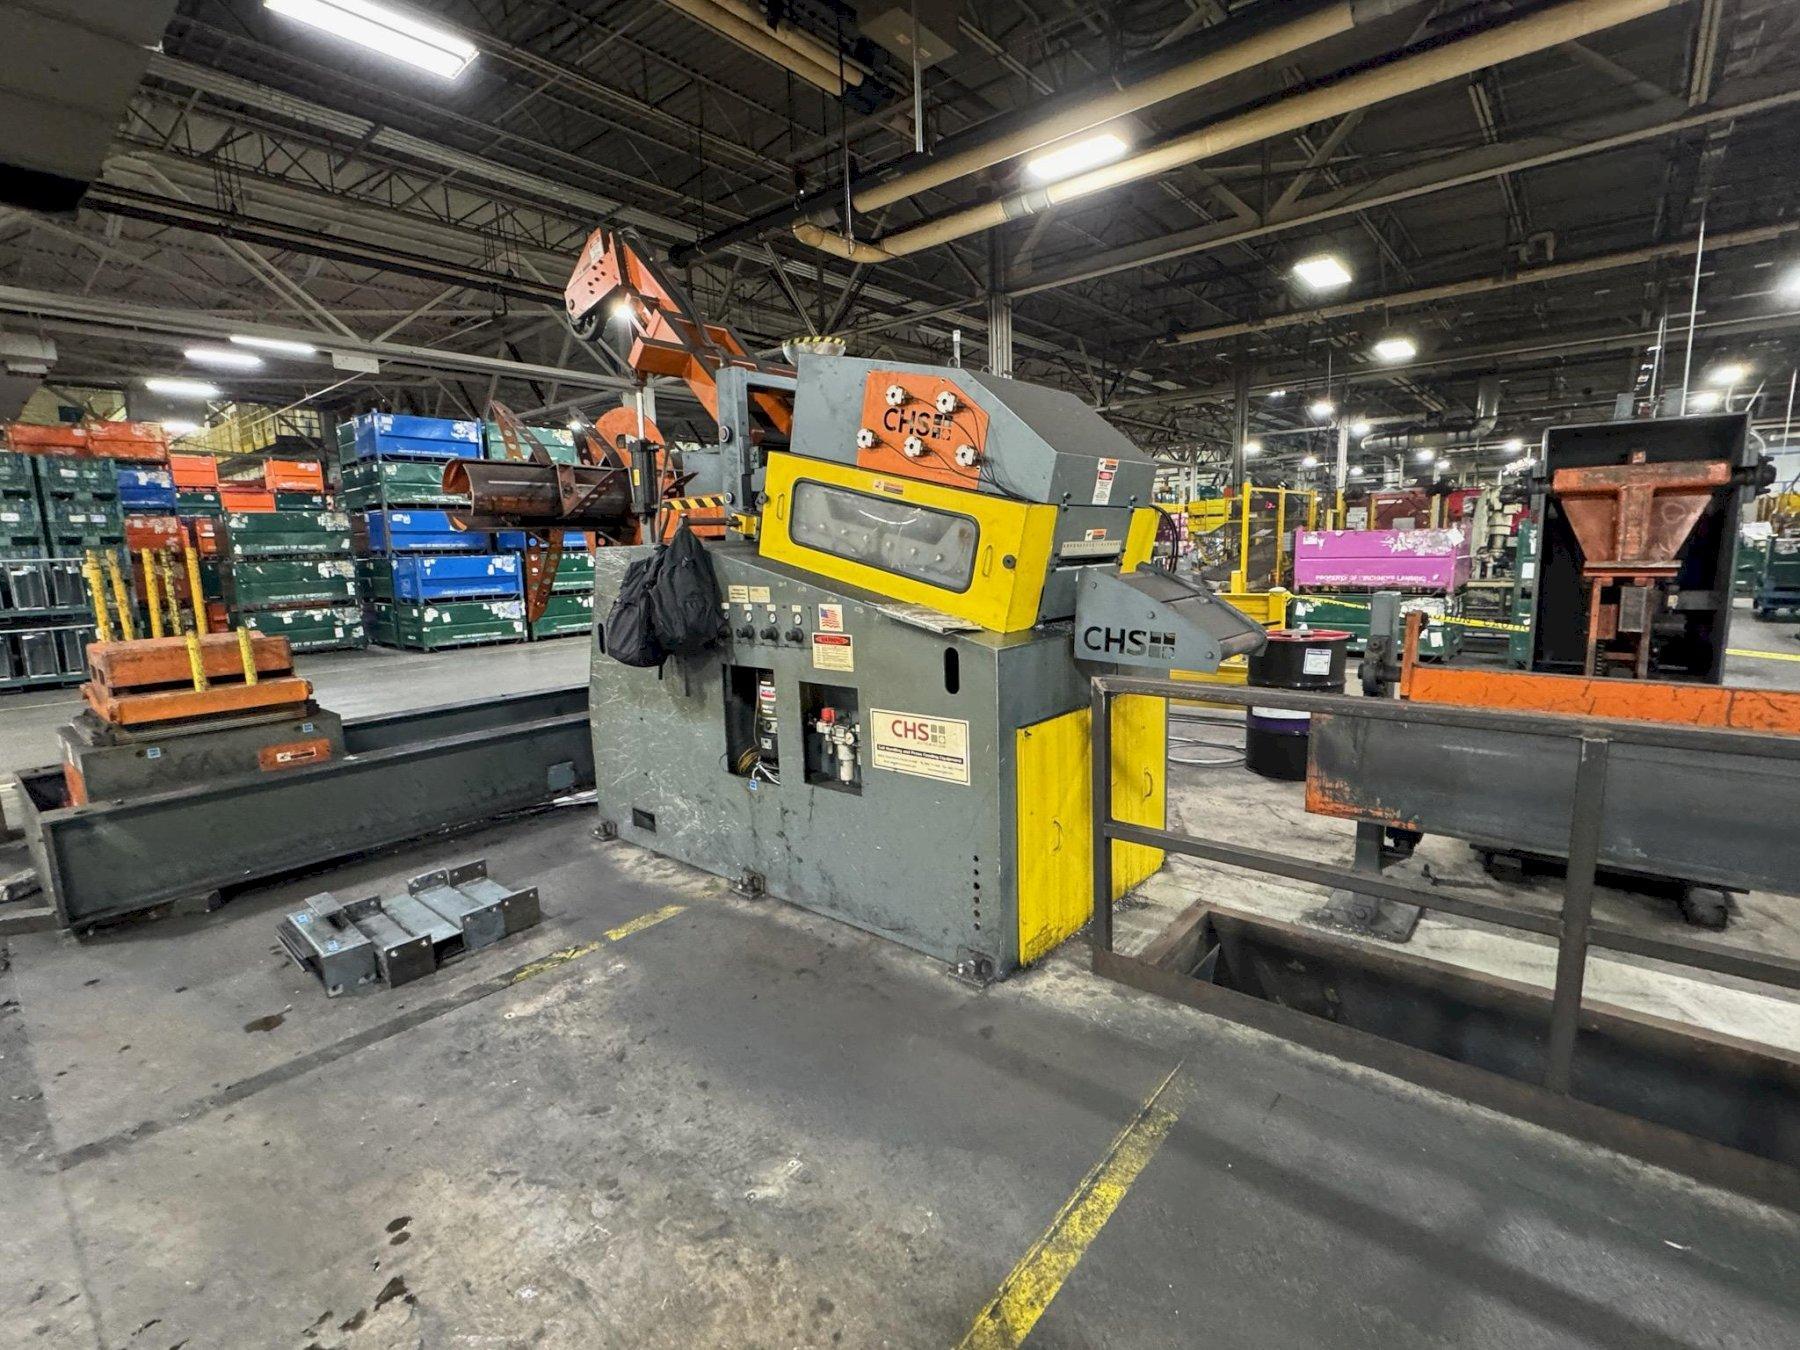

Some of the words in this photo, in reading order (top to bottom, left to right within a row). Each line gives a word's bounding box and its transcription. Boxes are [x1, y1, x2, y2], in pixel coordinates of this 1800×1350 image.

[884, 407, 931, 436] CHS
[1084, 626, 1147, 656] CHS
[891, 719, 929, 742] CHS
